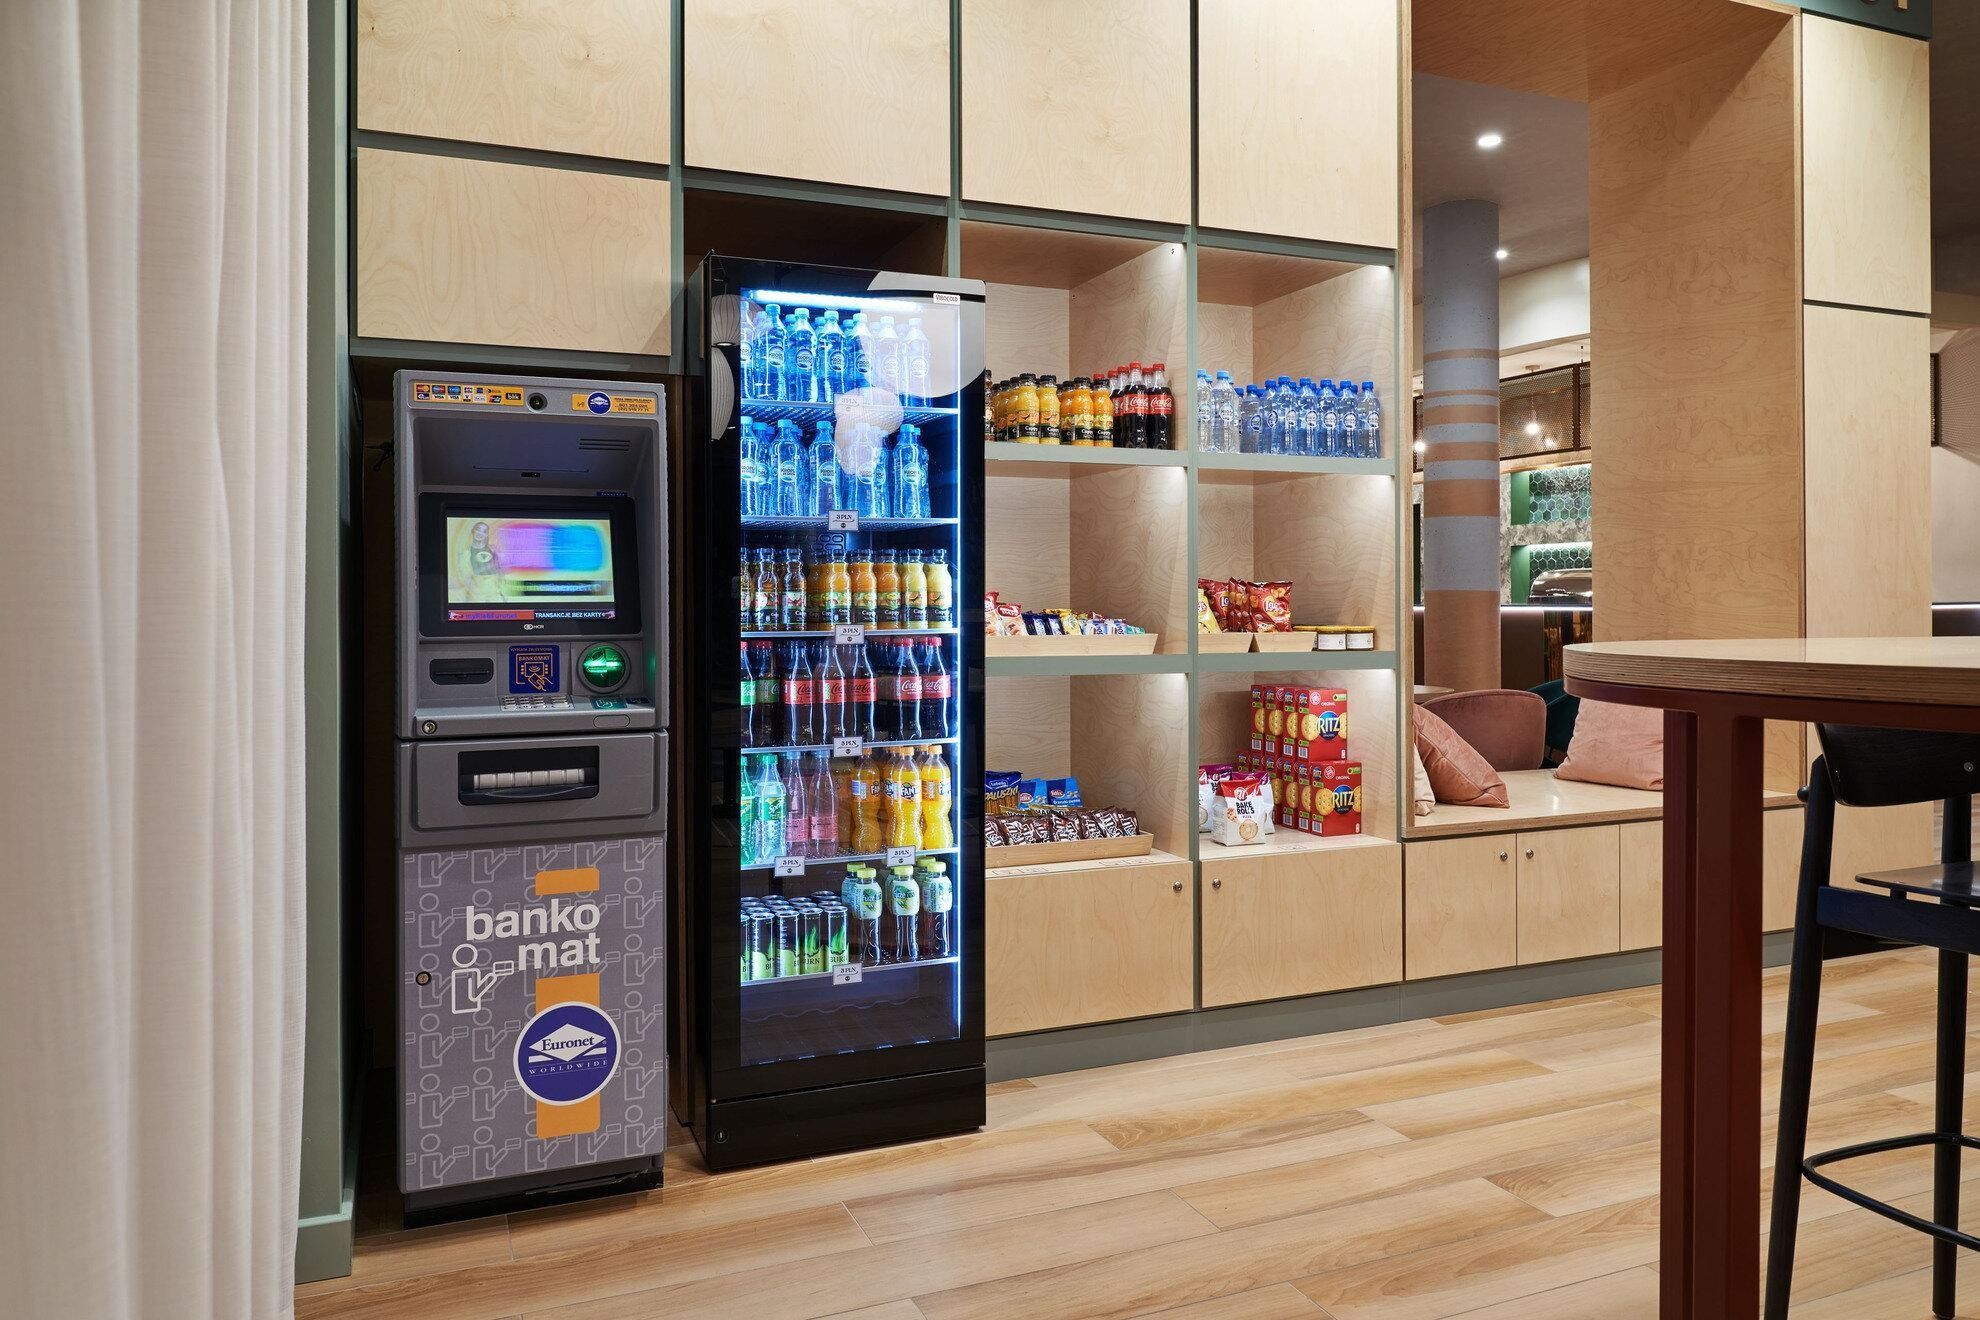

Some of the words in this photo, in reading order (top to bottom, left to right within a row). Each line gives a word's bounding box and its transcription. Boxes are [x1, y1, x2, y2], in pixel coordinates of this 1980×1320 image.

[1318, 717, 1340, 734] RITZ
[1333, 790, 1354, 808] RITZ
[466, 898, 600, 940] banko
[518, 932, 600, 970] mat
[541, 1036, 595, 1051] Euronet
[528, 1060, 608, 1075] WORLDWIDE
